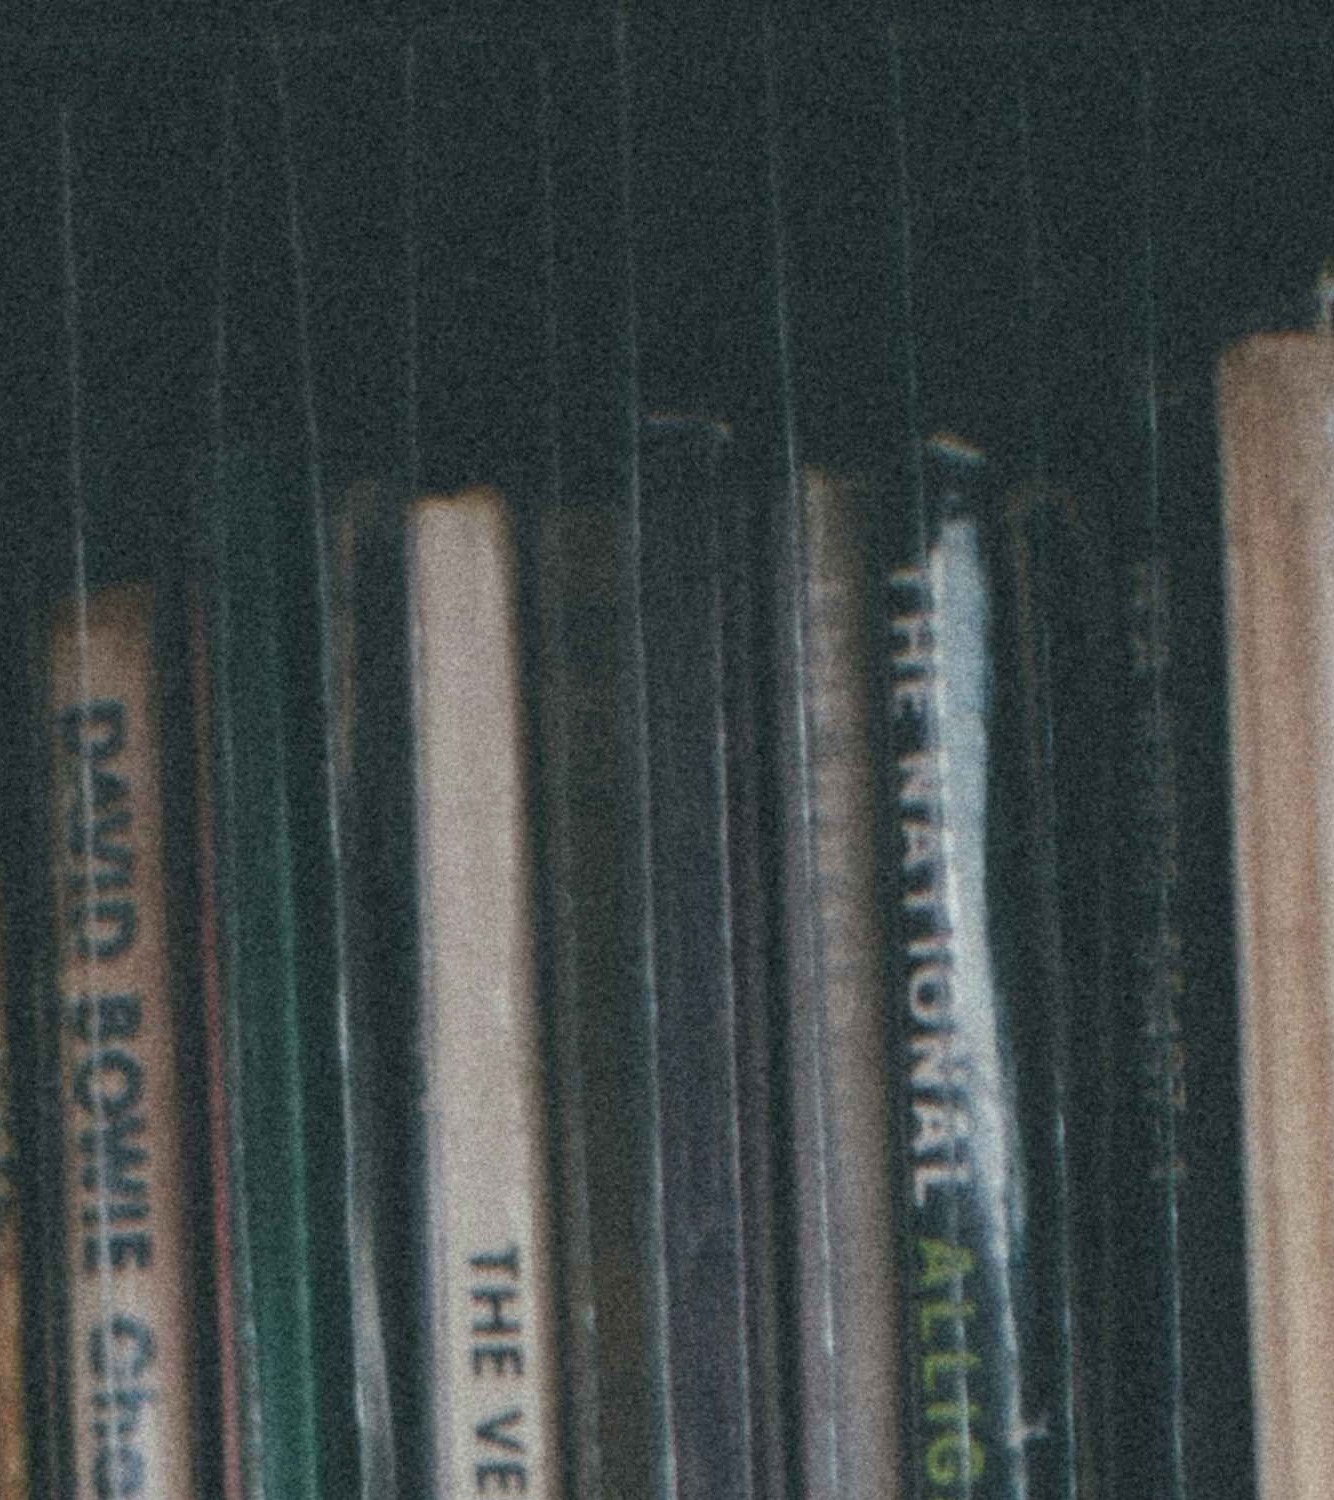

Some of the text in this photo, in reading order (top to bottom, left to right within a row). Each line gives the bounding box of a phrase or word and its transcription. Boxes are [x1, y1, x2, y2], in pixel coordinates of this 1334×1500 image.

[887, 566, 945, 718] THE
[59, 697, 137, 960] DAVID
[896, 750, 977, 1206] NATIONAL
[72, 988, 150, 1272] BOWIE
[467, 1246, 524, 1380] THE
